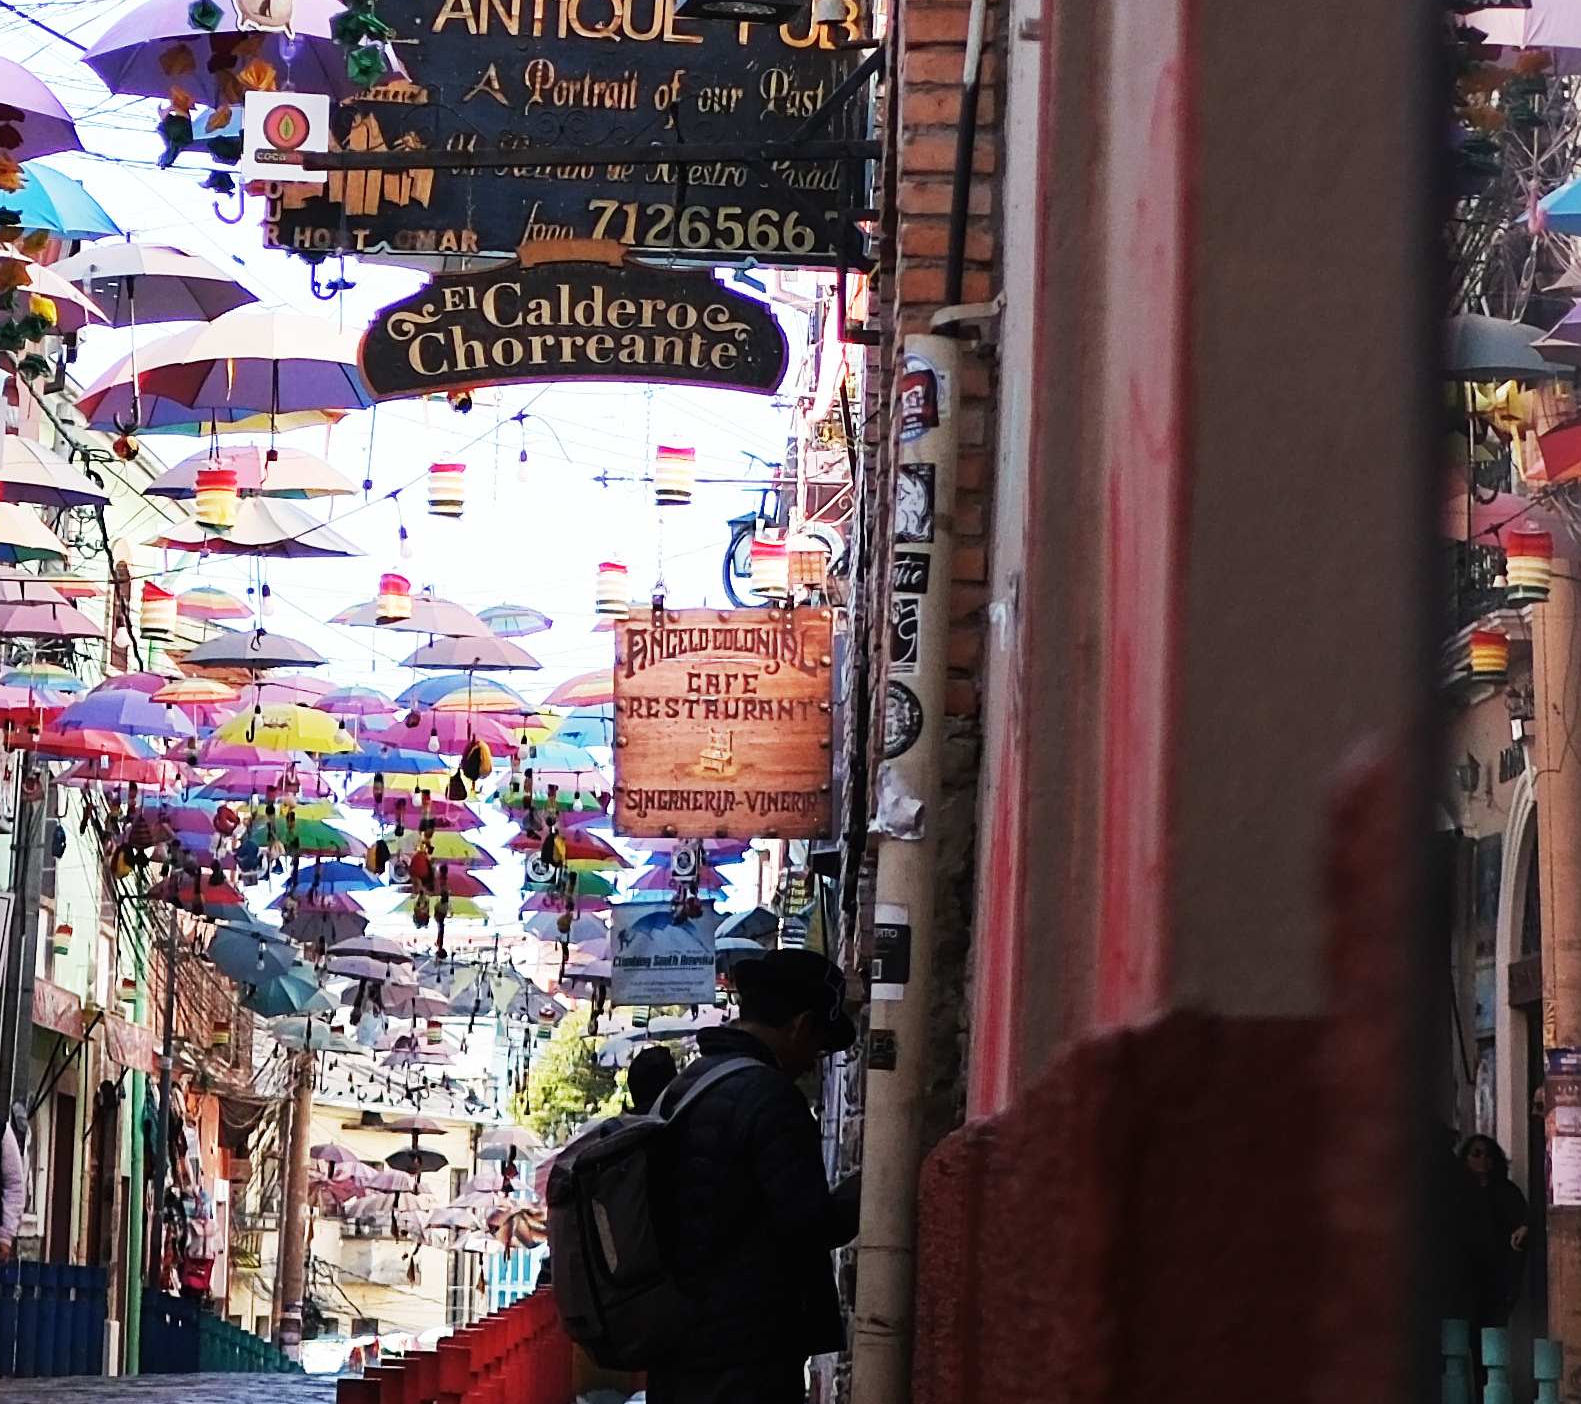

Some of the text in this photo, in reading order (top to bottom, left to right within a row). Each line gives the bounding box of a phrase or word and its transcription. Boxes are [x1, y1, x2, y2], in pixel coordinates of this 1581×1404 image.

[463, 61, 512, 107] A
[524, 57, 639, 116] Portrait
[654, 68, 688, 130] of
[696, 85, 744, 114] our
[588, 198, 839, 254] 7126566
[442, 281, 697, 332] El Caldero
[408, 323, 740, 378] Chorreante
[628, 697, 815, 723] RESTAURANT
[685, 671, 760, 696] CAFE
